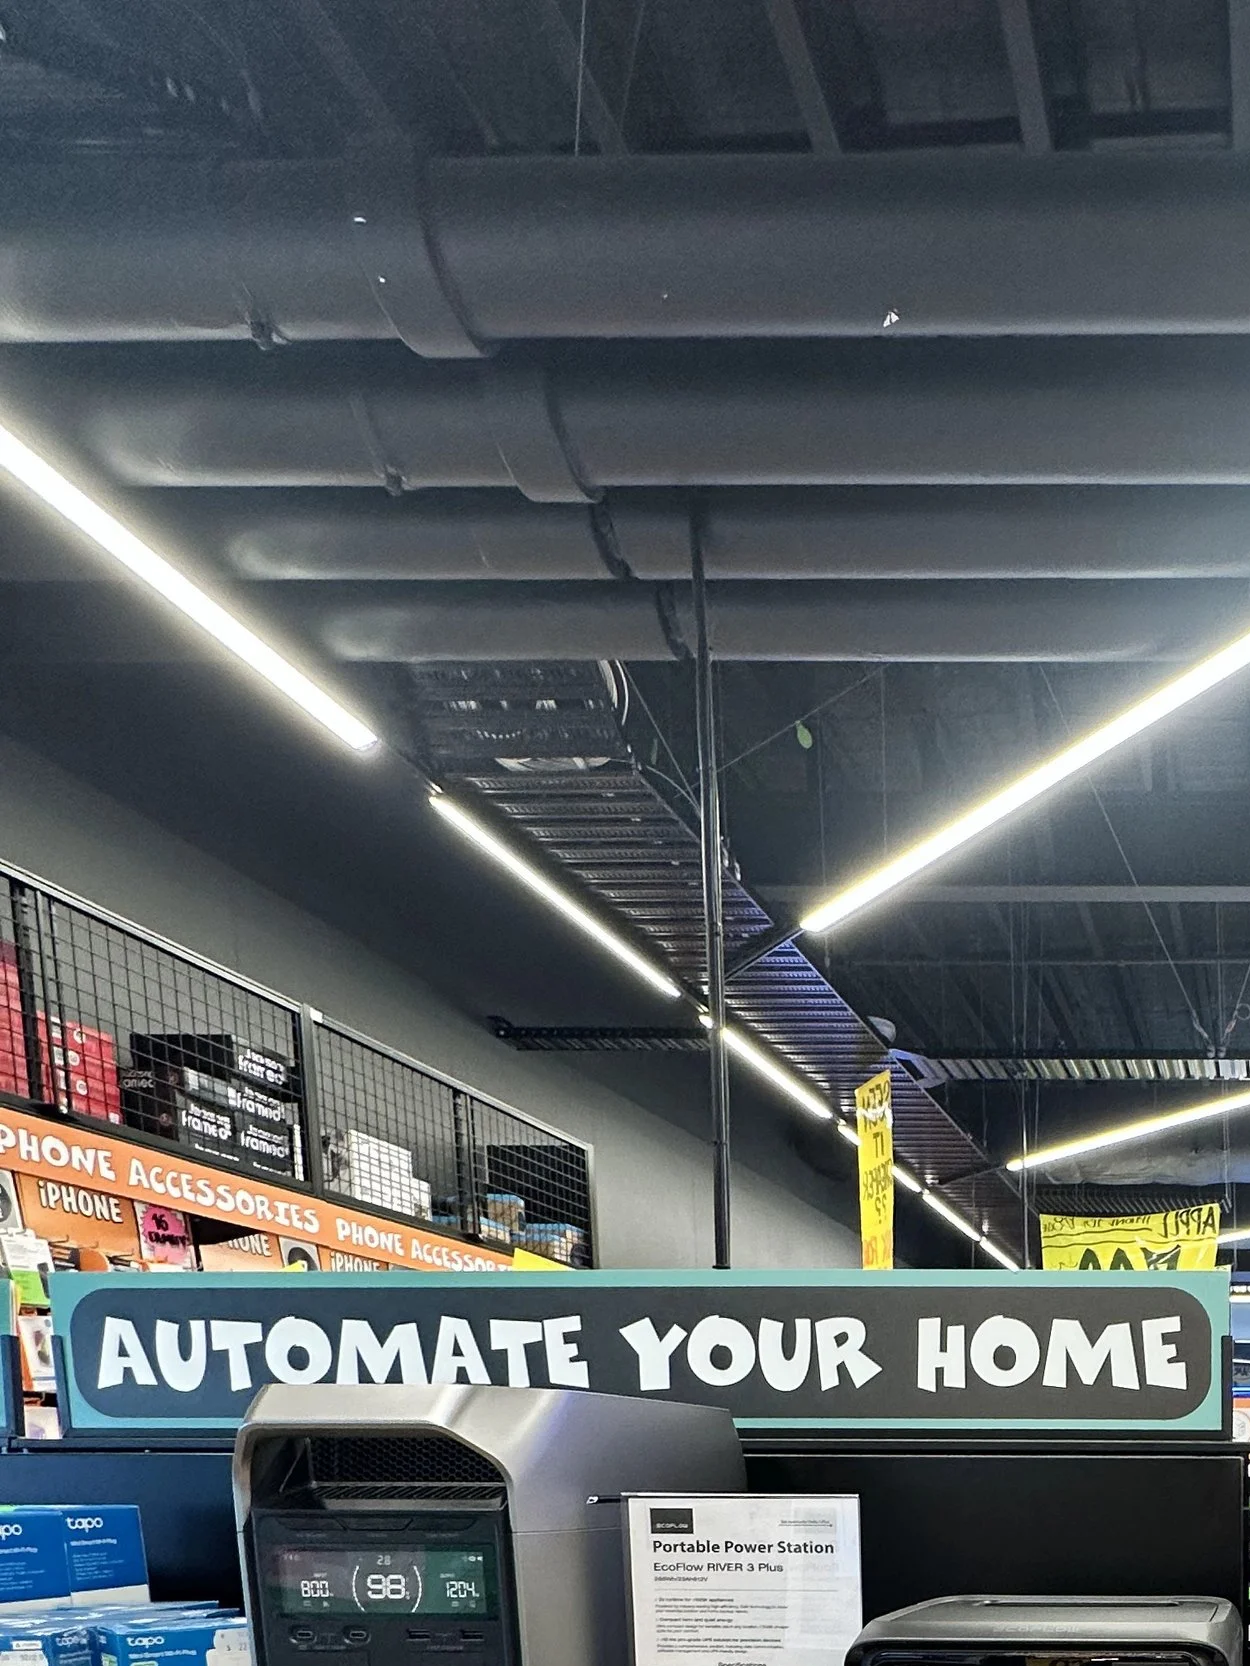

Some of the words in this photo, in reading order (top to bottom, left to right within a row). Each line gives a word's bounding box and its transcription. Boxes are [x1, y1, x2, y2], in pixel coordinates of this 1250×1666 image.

[0, 1122, 116, 1182] PHONE
[128, 1158, 320, 1234] ACCESSORIES
[37, 1180, 123, 1223] iPHONE
[98, 1315, 589, 1392] AUTOMATE
[619, 1315, 883, 1392] YOUR
[917, 1315, 1188, 1393] HOME
[66, 1516, 104, 1534] tapo
[652, 1540, 720, 1555] Portable
[724, 1540, 774, 1555] Power
[777, 1540, 835, 1555] Station
[653, 1562, 704, 1573] EcoFlow
[707, 1562, 743, 1572] RIVER
[747, 1562, 755, 1572] 3
[758, 1562, 784, 1573] Plus
[126, 1636, 164, 1648] tapo
